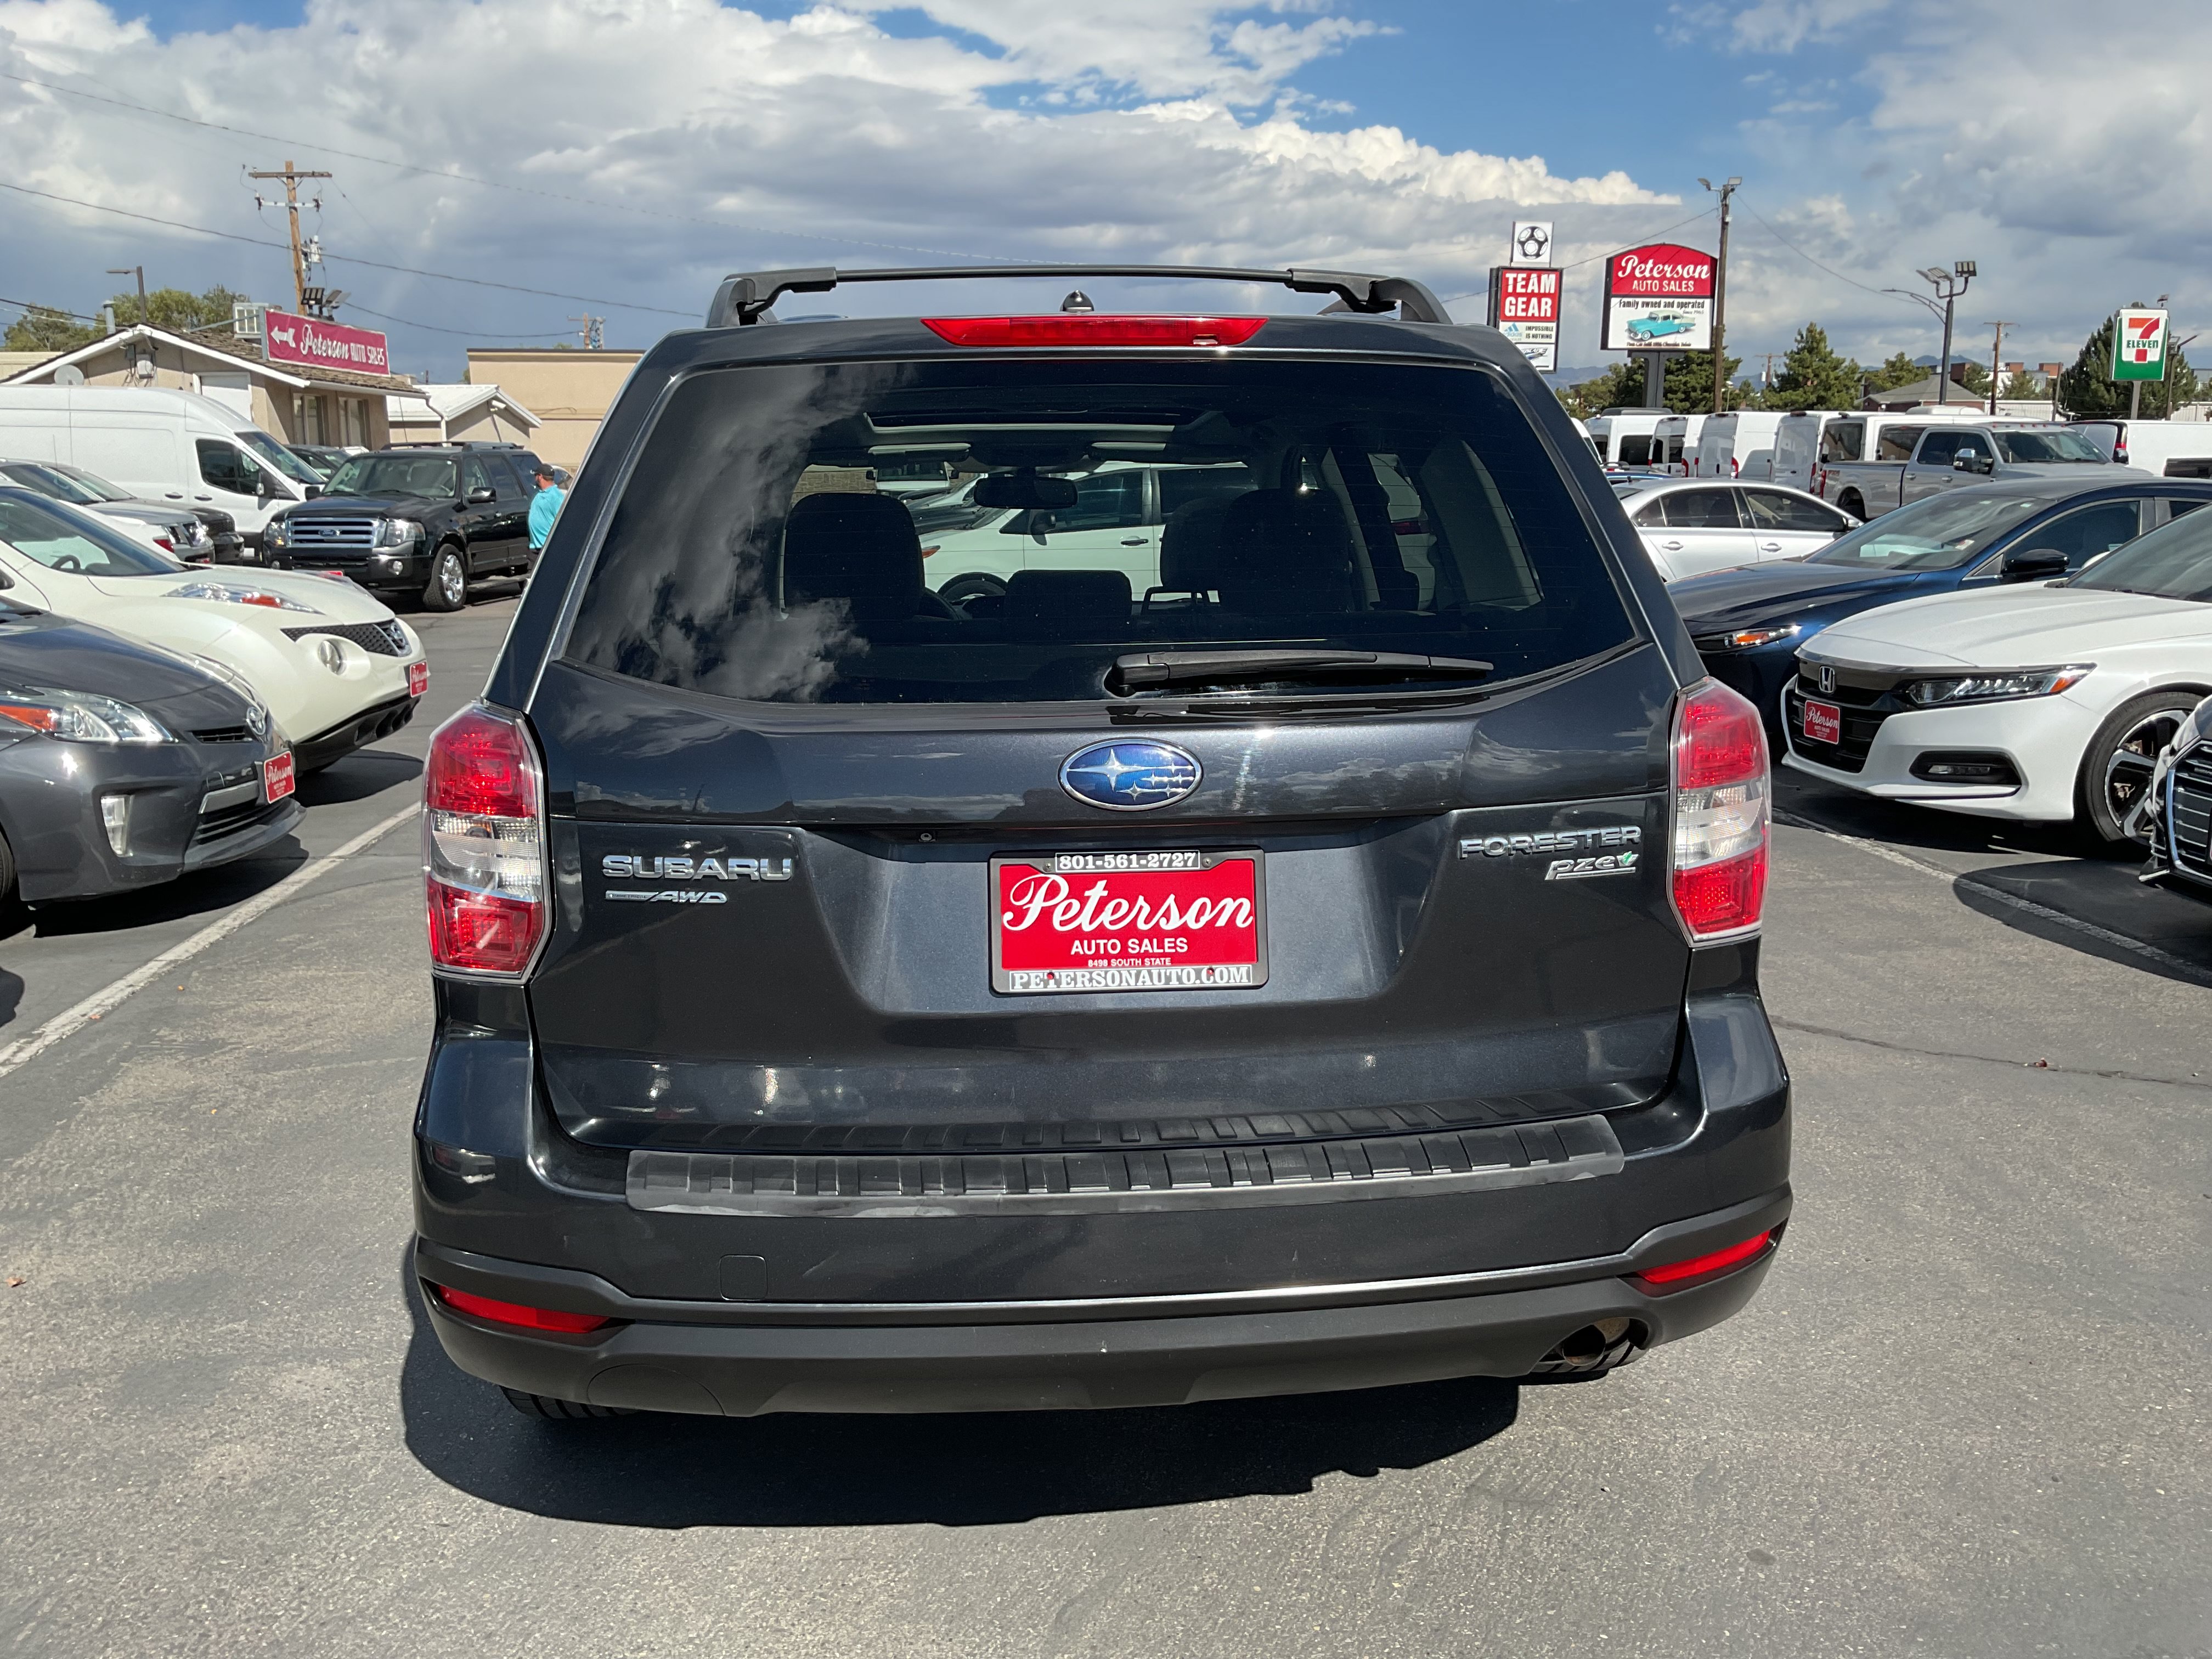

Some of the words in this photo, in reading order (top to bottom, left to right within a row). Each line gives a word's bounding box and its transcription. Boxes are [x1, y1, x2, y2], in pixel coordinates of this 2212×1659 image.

[1618, 255, 1710, 279] Peterson
[1505, 273, 1555, 293] TEAM
[1633, 280, 1659, 291] AUTO
[1663, 280, 1694, 292] SALES
[1504, 296, 1551, 317] GEAR
[1619, 300, 1639, 309] Family
[1641, 300, 1661, 308] owned
[1663, 300, 1674, 308] and
[1677, 300, 1705, 309] operated
[300, 324, 349, 360] Peterson
[351, 342, 366, 362] AUTO
[367, 346, 385, 365] SALES
[2129, 317, 2160, 362] 7
[1806, 707, 1838, 729] Peterson
[267, 765, 292, 785] Peterson
[1459, 825, 1641, 859] FORESTER
[602, 855, 792, 881] SUBARU
[1059, 852, 1197, 870] 801-561-2727
[650, 890, 728, 904] AWD
[1003, 873, 1254, 932] Peterson
[1071, 939, 1120, 955] AUTO
[1127, 938, 1188, 953] SALES
[1088, 958, 1108, 967] 8498
[1111, 958, 1142, 967] SOUTH
[1144, 957, 1172, 966] STATE
[1013, 967, 1249, 990] PETERSONAUTO.COM
